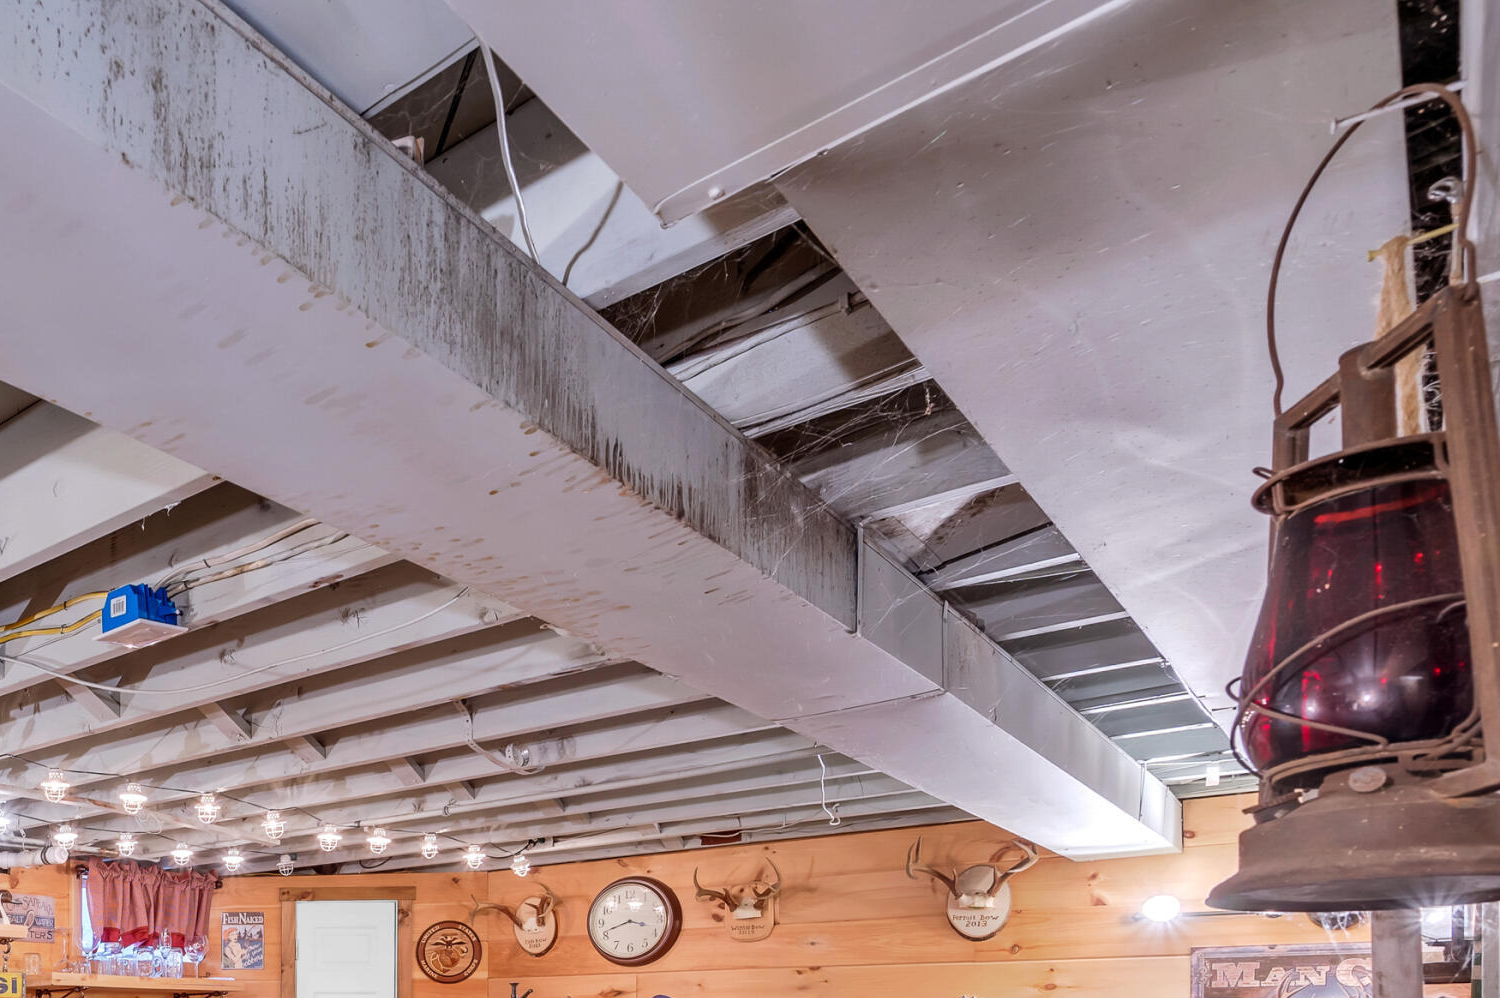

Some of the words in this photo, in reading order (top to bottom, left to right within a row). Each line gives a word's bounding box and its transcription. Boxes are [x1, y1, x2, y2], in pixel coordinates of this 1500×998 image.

[624, 889, 636, 900] 12
[602, 906, 613, 915] 10
[598, 918, 605, 929] 9
[965, 920, 988, 928] 2013
[602, 931, 609, 940] 8
[613, 940, 620, 950] 7
[626, 942, 634, 953] 6
[641, 937, 649, 948] 5
[1211, 961, 1330, 988] MAN
